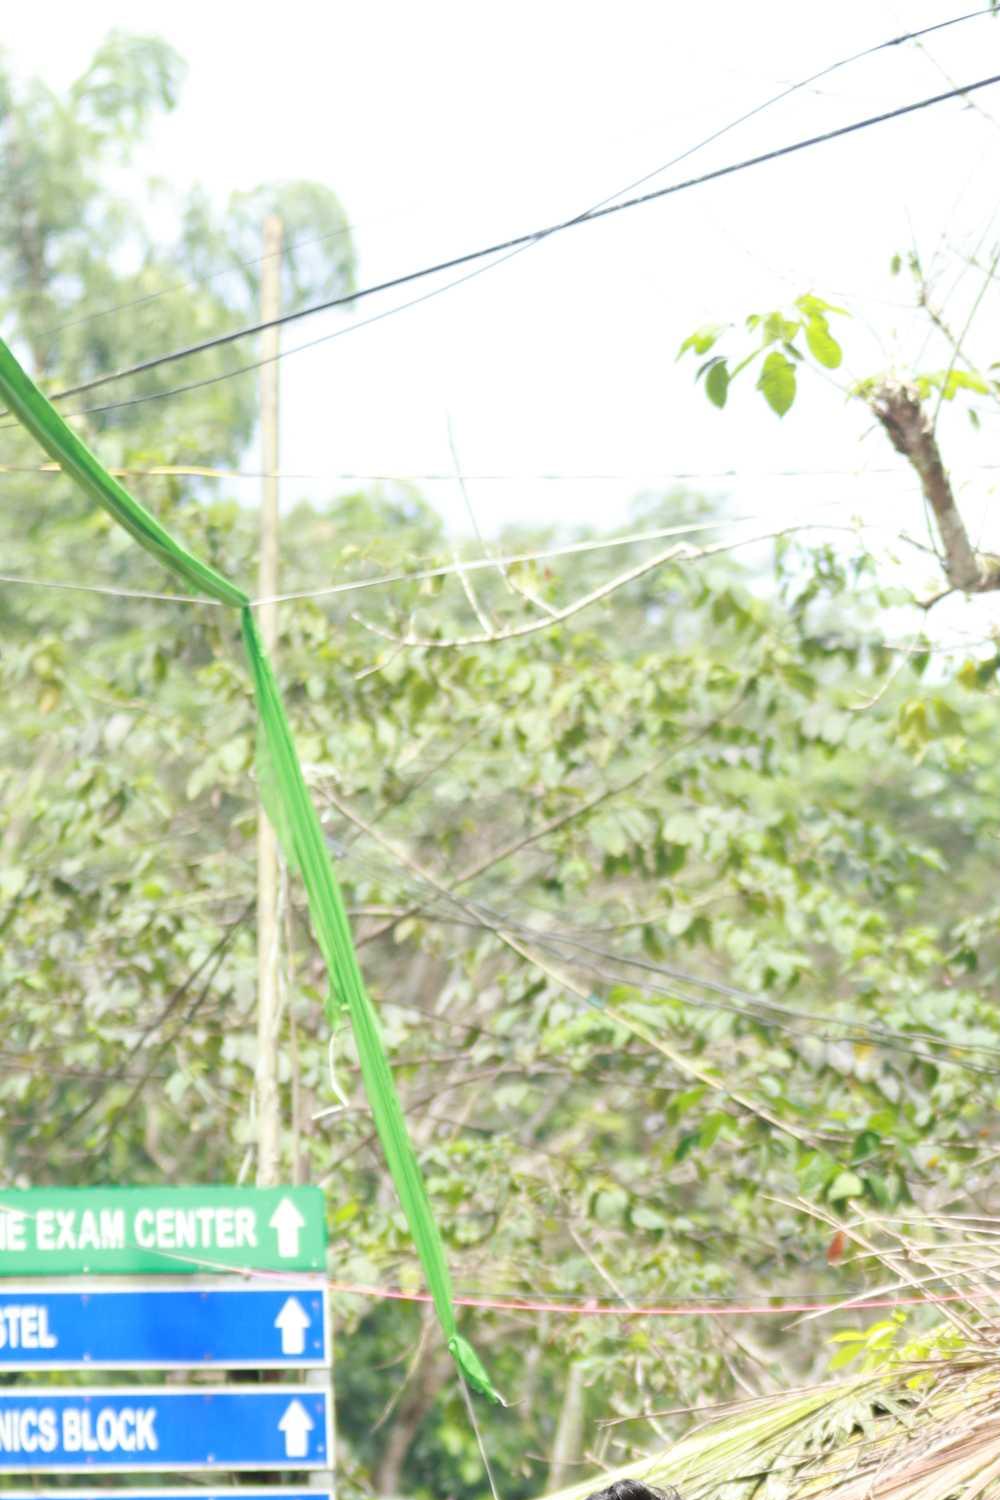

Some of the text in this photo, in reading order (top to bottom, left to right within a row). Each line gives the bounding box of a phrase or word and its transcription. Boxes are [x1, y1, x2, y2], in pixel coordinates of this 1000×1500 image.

[36, 1209, 125, 1250] EXAM
[134, 1207, 257, 1249] CENTER
[62, 1407, 158, 1452] BLOCK
